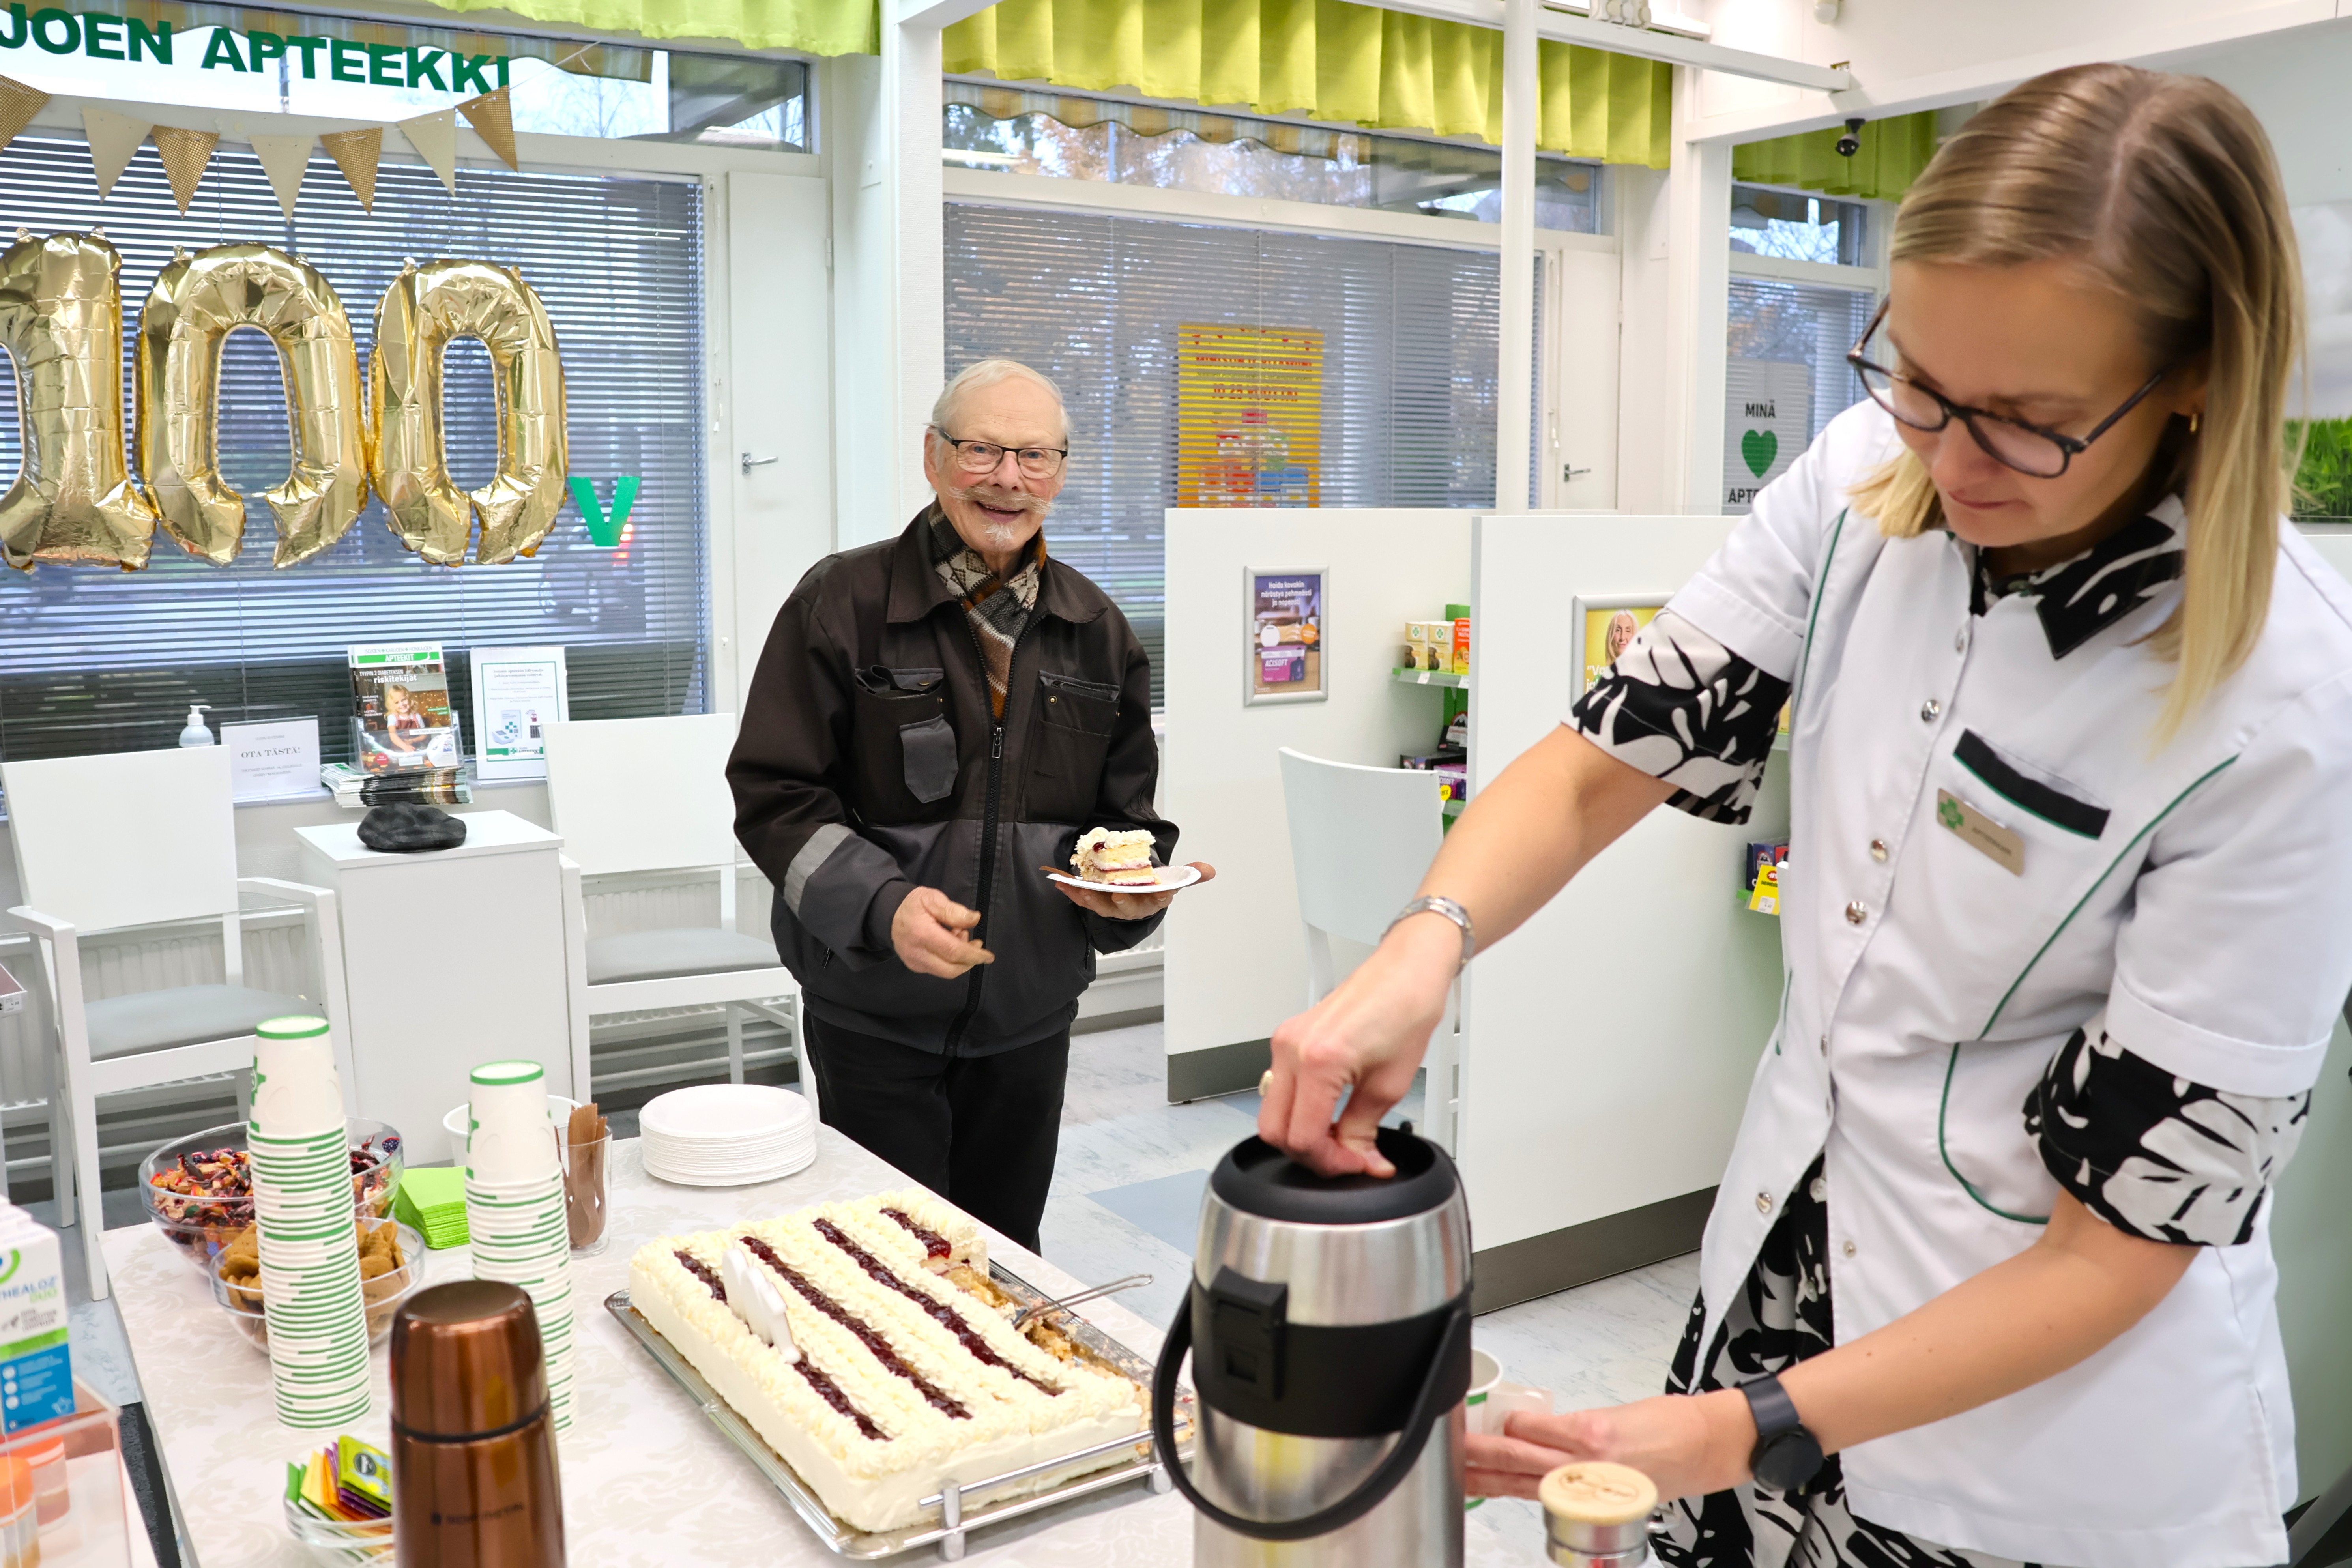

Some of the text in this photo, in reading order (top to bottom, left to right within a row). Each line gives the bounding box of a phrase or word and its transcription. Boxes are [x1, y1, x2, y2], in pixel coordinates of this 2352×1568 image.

[202, 28, 509, 95] APTEEKKI
[1745, 399, 1776, 418] MINÄ
[385, 653, 414, 662] APTEEKIT
[373, 674, 417, 683] riskitekijät
[264, 746, 301, 756] TÄSTÄ!
[1439, 777, 1454, 785] CISOFT
[0, 1274, 57, 1301] HEALOZ
